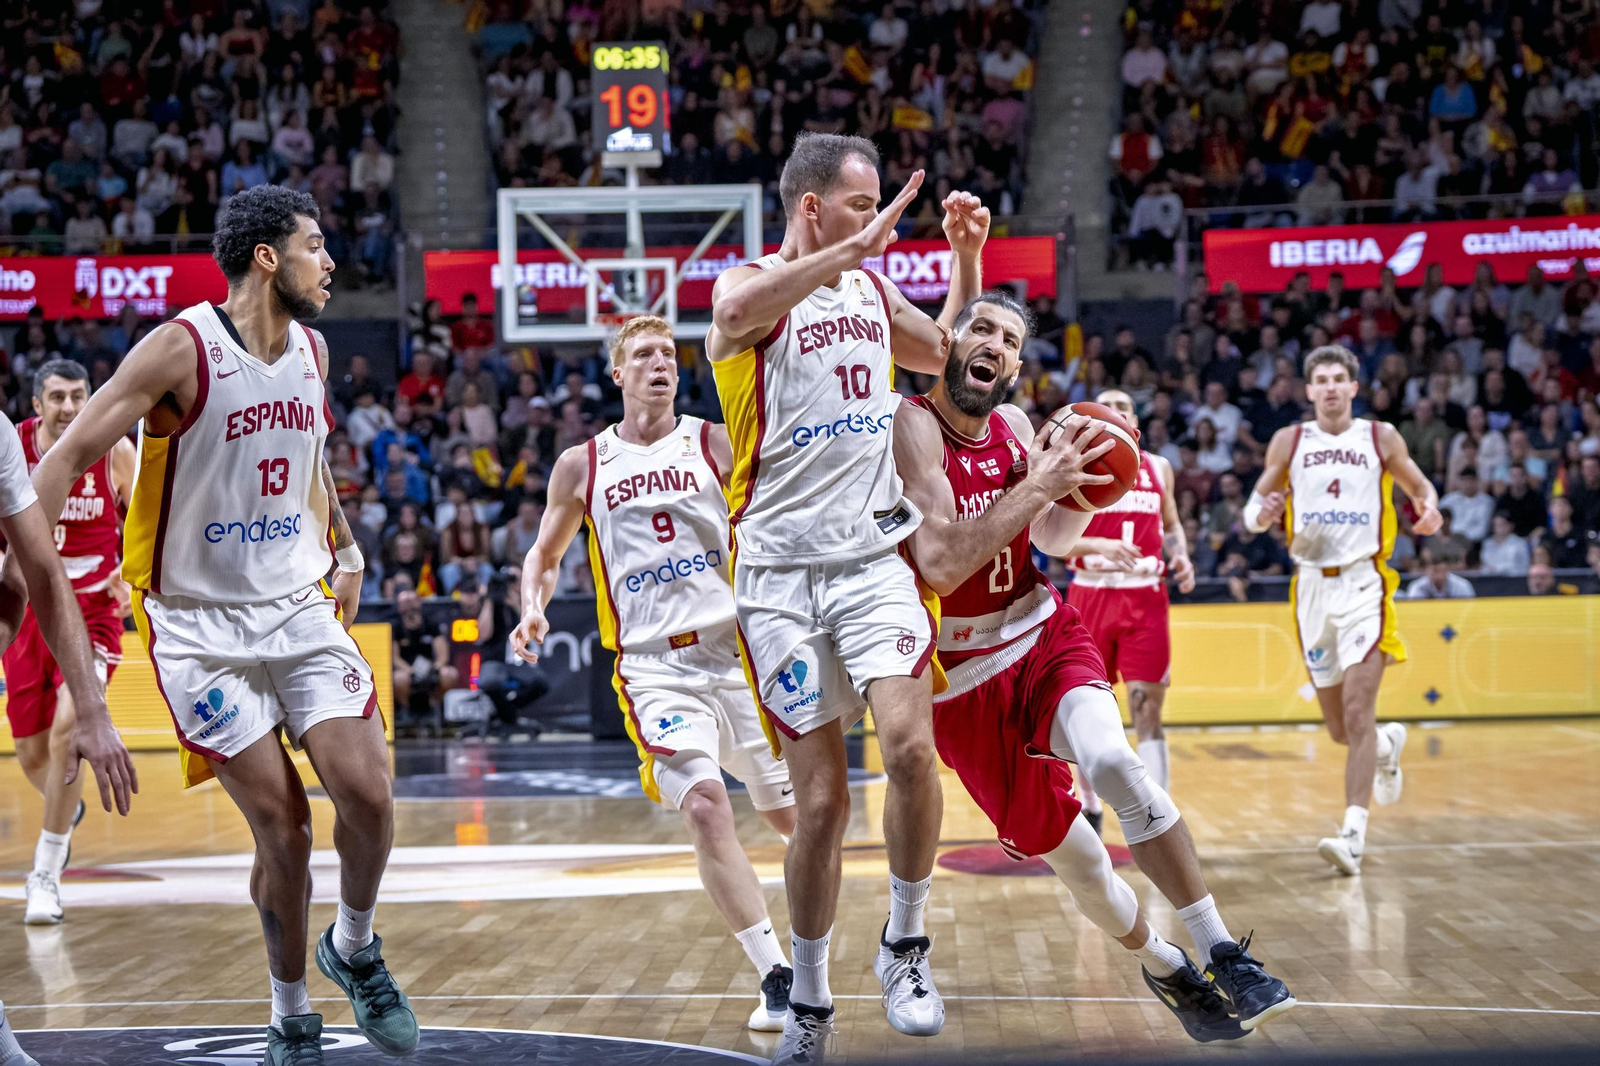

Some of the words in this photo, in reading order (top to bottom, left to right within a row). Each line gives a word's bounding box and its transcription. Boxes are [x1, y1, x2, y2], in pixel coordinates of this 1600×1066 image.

[594, 46, 660, 70] 06:35
[600, 84, 658, 127] 19
[1270, 237, 1383, 267] IBERIA
[101, 265, 173, 298] DXT
[796, 313, 885, 356] ESPAÑA
[834, 364, 872, 401] 10
[225, 396, 315, 443] ESPAÑA
[1303, 448, 1369, 470] ESPAÑA
[257, 457, 290, 497] 13
[604, 465, 701, 512] ESPAÑA
[1326, 478, 1341, 500] 4
[204, 513, 302, 544] endesa
[651, 511, 677, 544] 9
[1302, 508, 1371, 526] endesa
[625, 549, 722, 593] endesa
[988, 546, 1014, 594] 23
[199, 704, 240, 739] tenerife!
